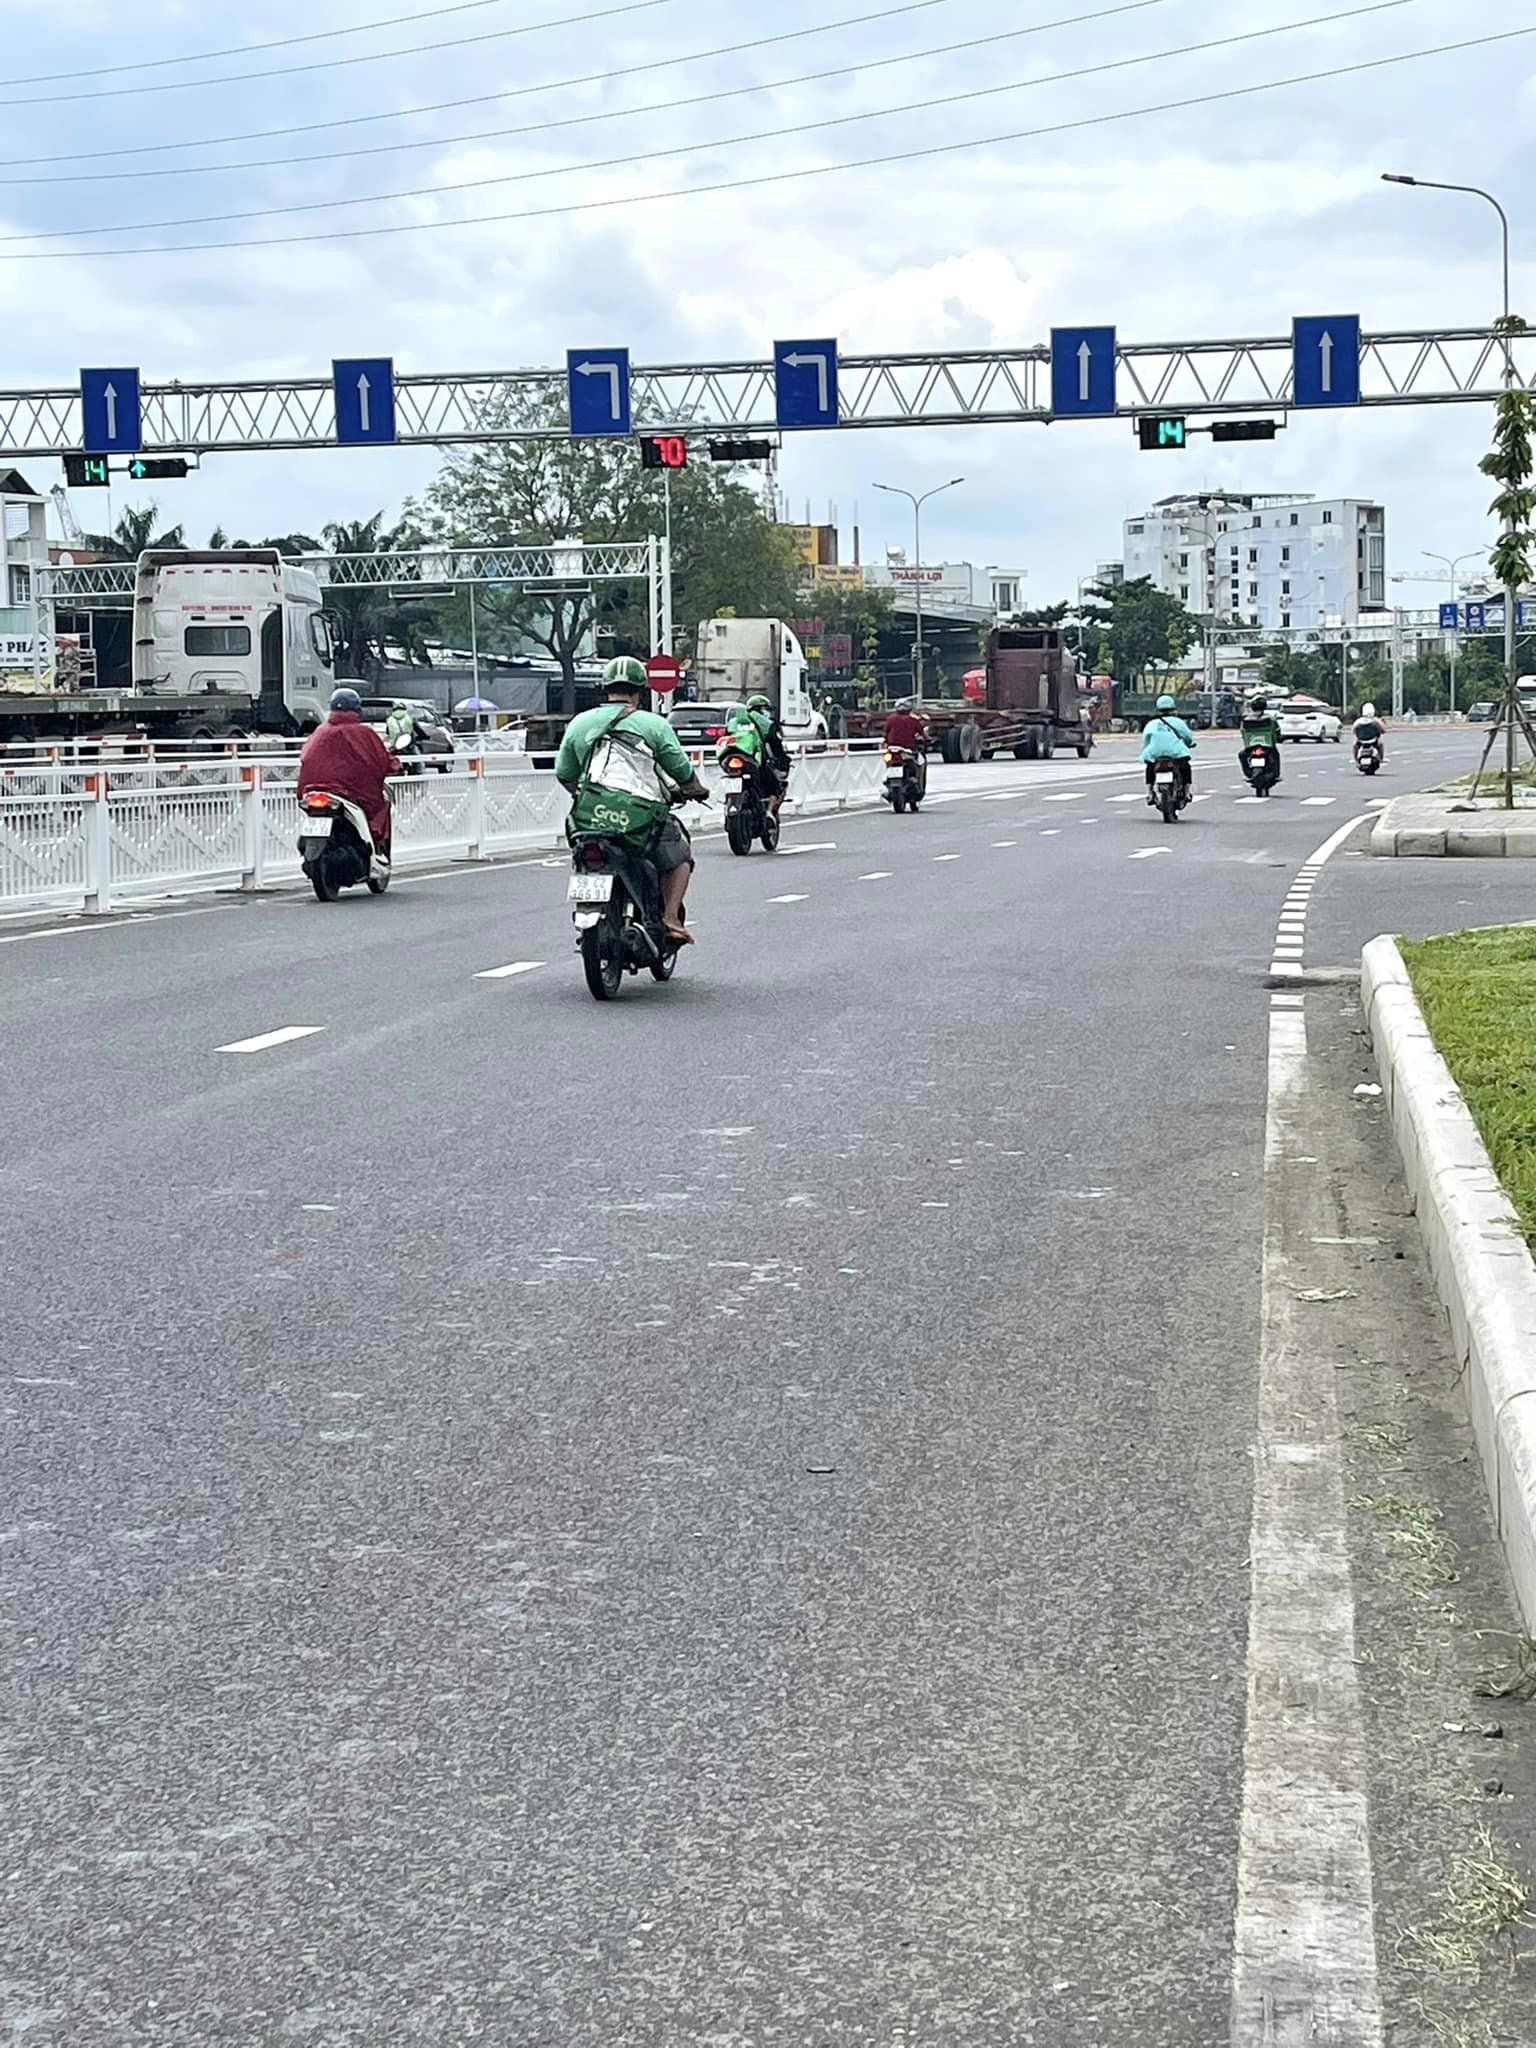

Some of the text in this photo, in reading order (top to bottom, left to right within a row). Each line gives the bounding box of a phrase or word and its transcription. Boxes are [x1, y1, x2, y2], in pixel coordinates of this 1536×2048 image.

[1159, 420, 1183, 445] 14
[653, 438, 684, 465] 70
[84, 460, 105, 481] 14
[593, 803, 630, 826] Grab
